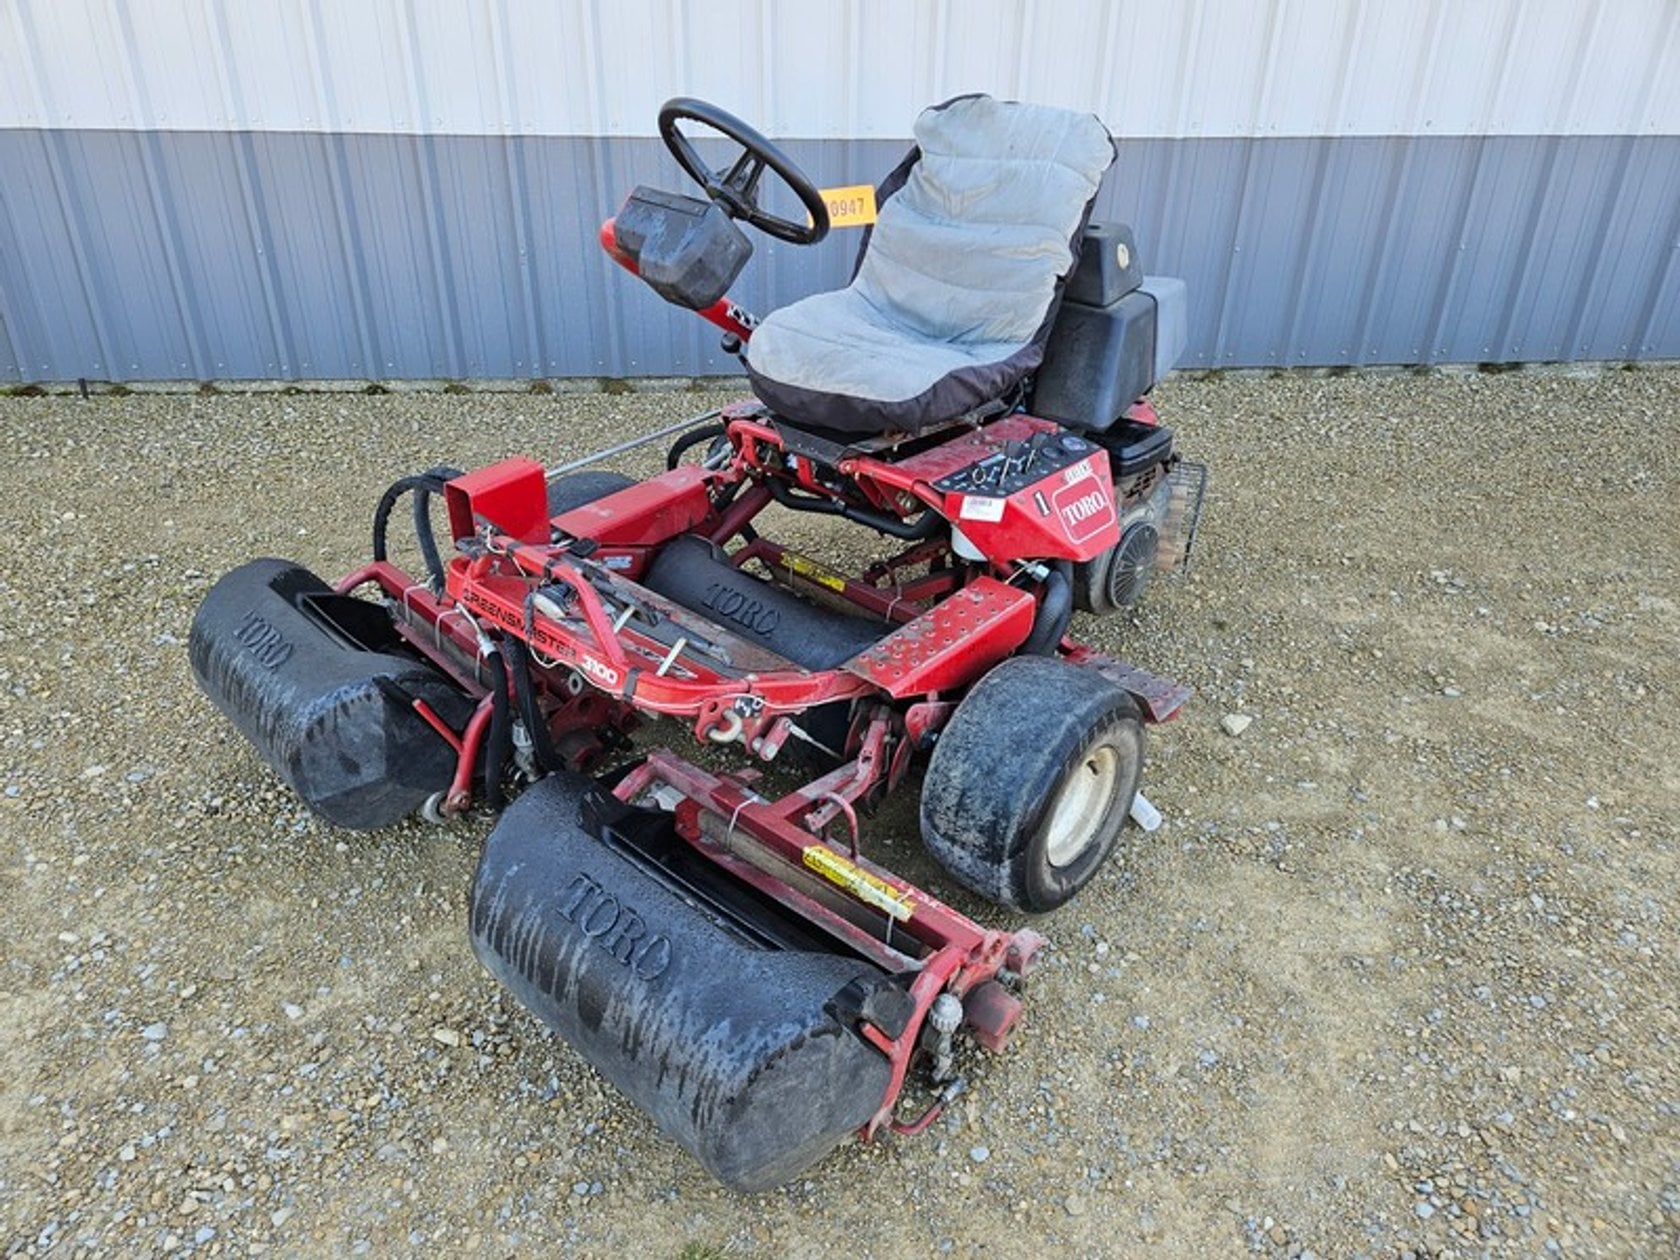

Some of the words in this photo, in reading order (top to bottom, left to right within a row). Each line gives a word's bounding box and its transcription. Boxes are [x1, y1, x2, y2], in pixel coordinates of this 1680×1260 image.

[826, 197, 865, 217] 0947
[1061, 491, 1104, 525] TORO
[702, 583, 781, 636] TORO
[233, 609, 294, 670] TORO
[556, 871, 673, 982] TORO
